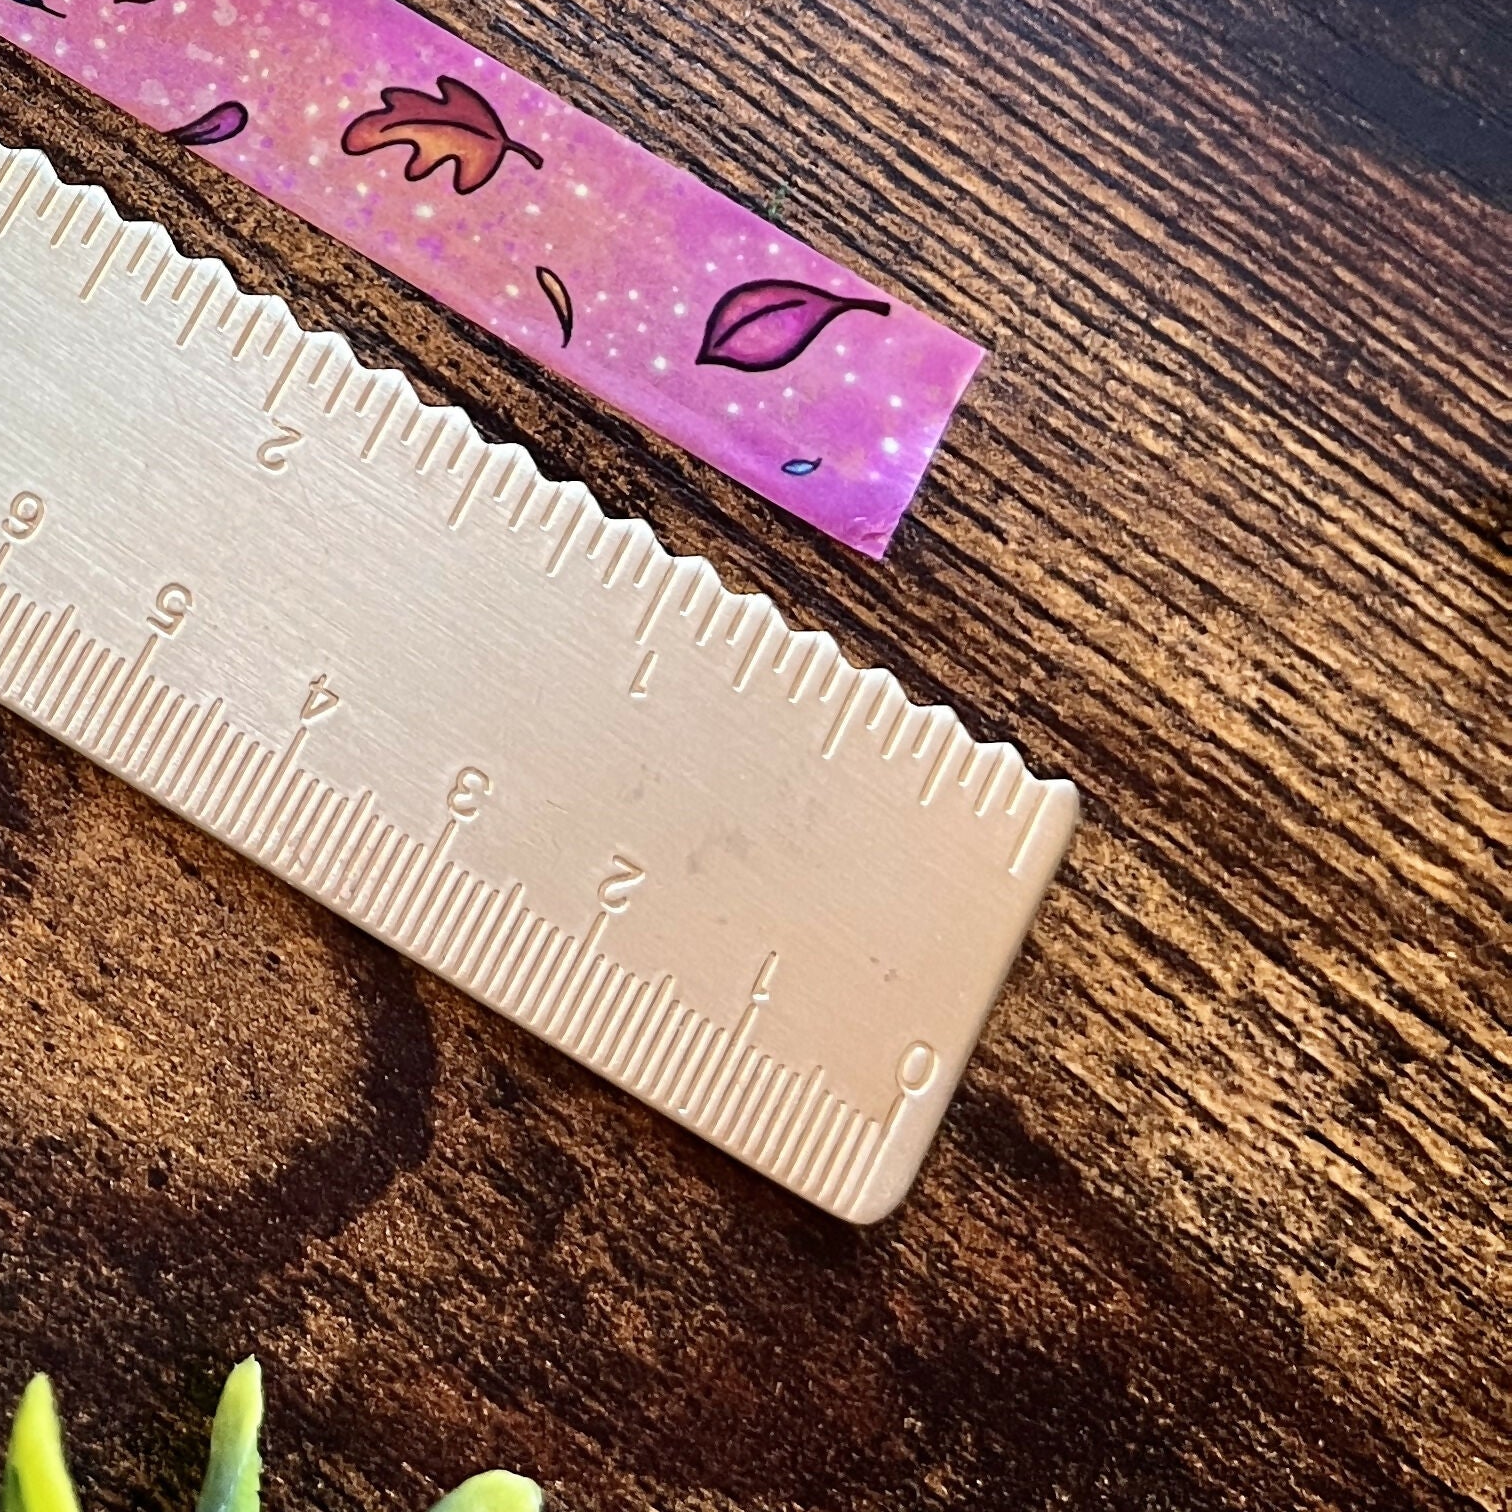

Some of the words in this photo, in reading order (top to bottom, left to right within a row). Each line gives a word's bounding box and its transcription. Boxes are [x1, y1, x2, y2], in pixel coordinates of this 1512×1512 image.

[257, 421, 303, 472] 2
[1, 491, 46, 541] 6
[147, 582, 193, 637] 5
[300, 674, 340, 720] 4
[630, 650, 657, 698] 1
[447, 767, 491, 821] 3
[597, 855, 645, 913] 2
[751, 951, 779, 1002] 1
[897, 1040, 936, 1094] 0
